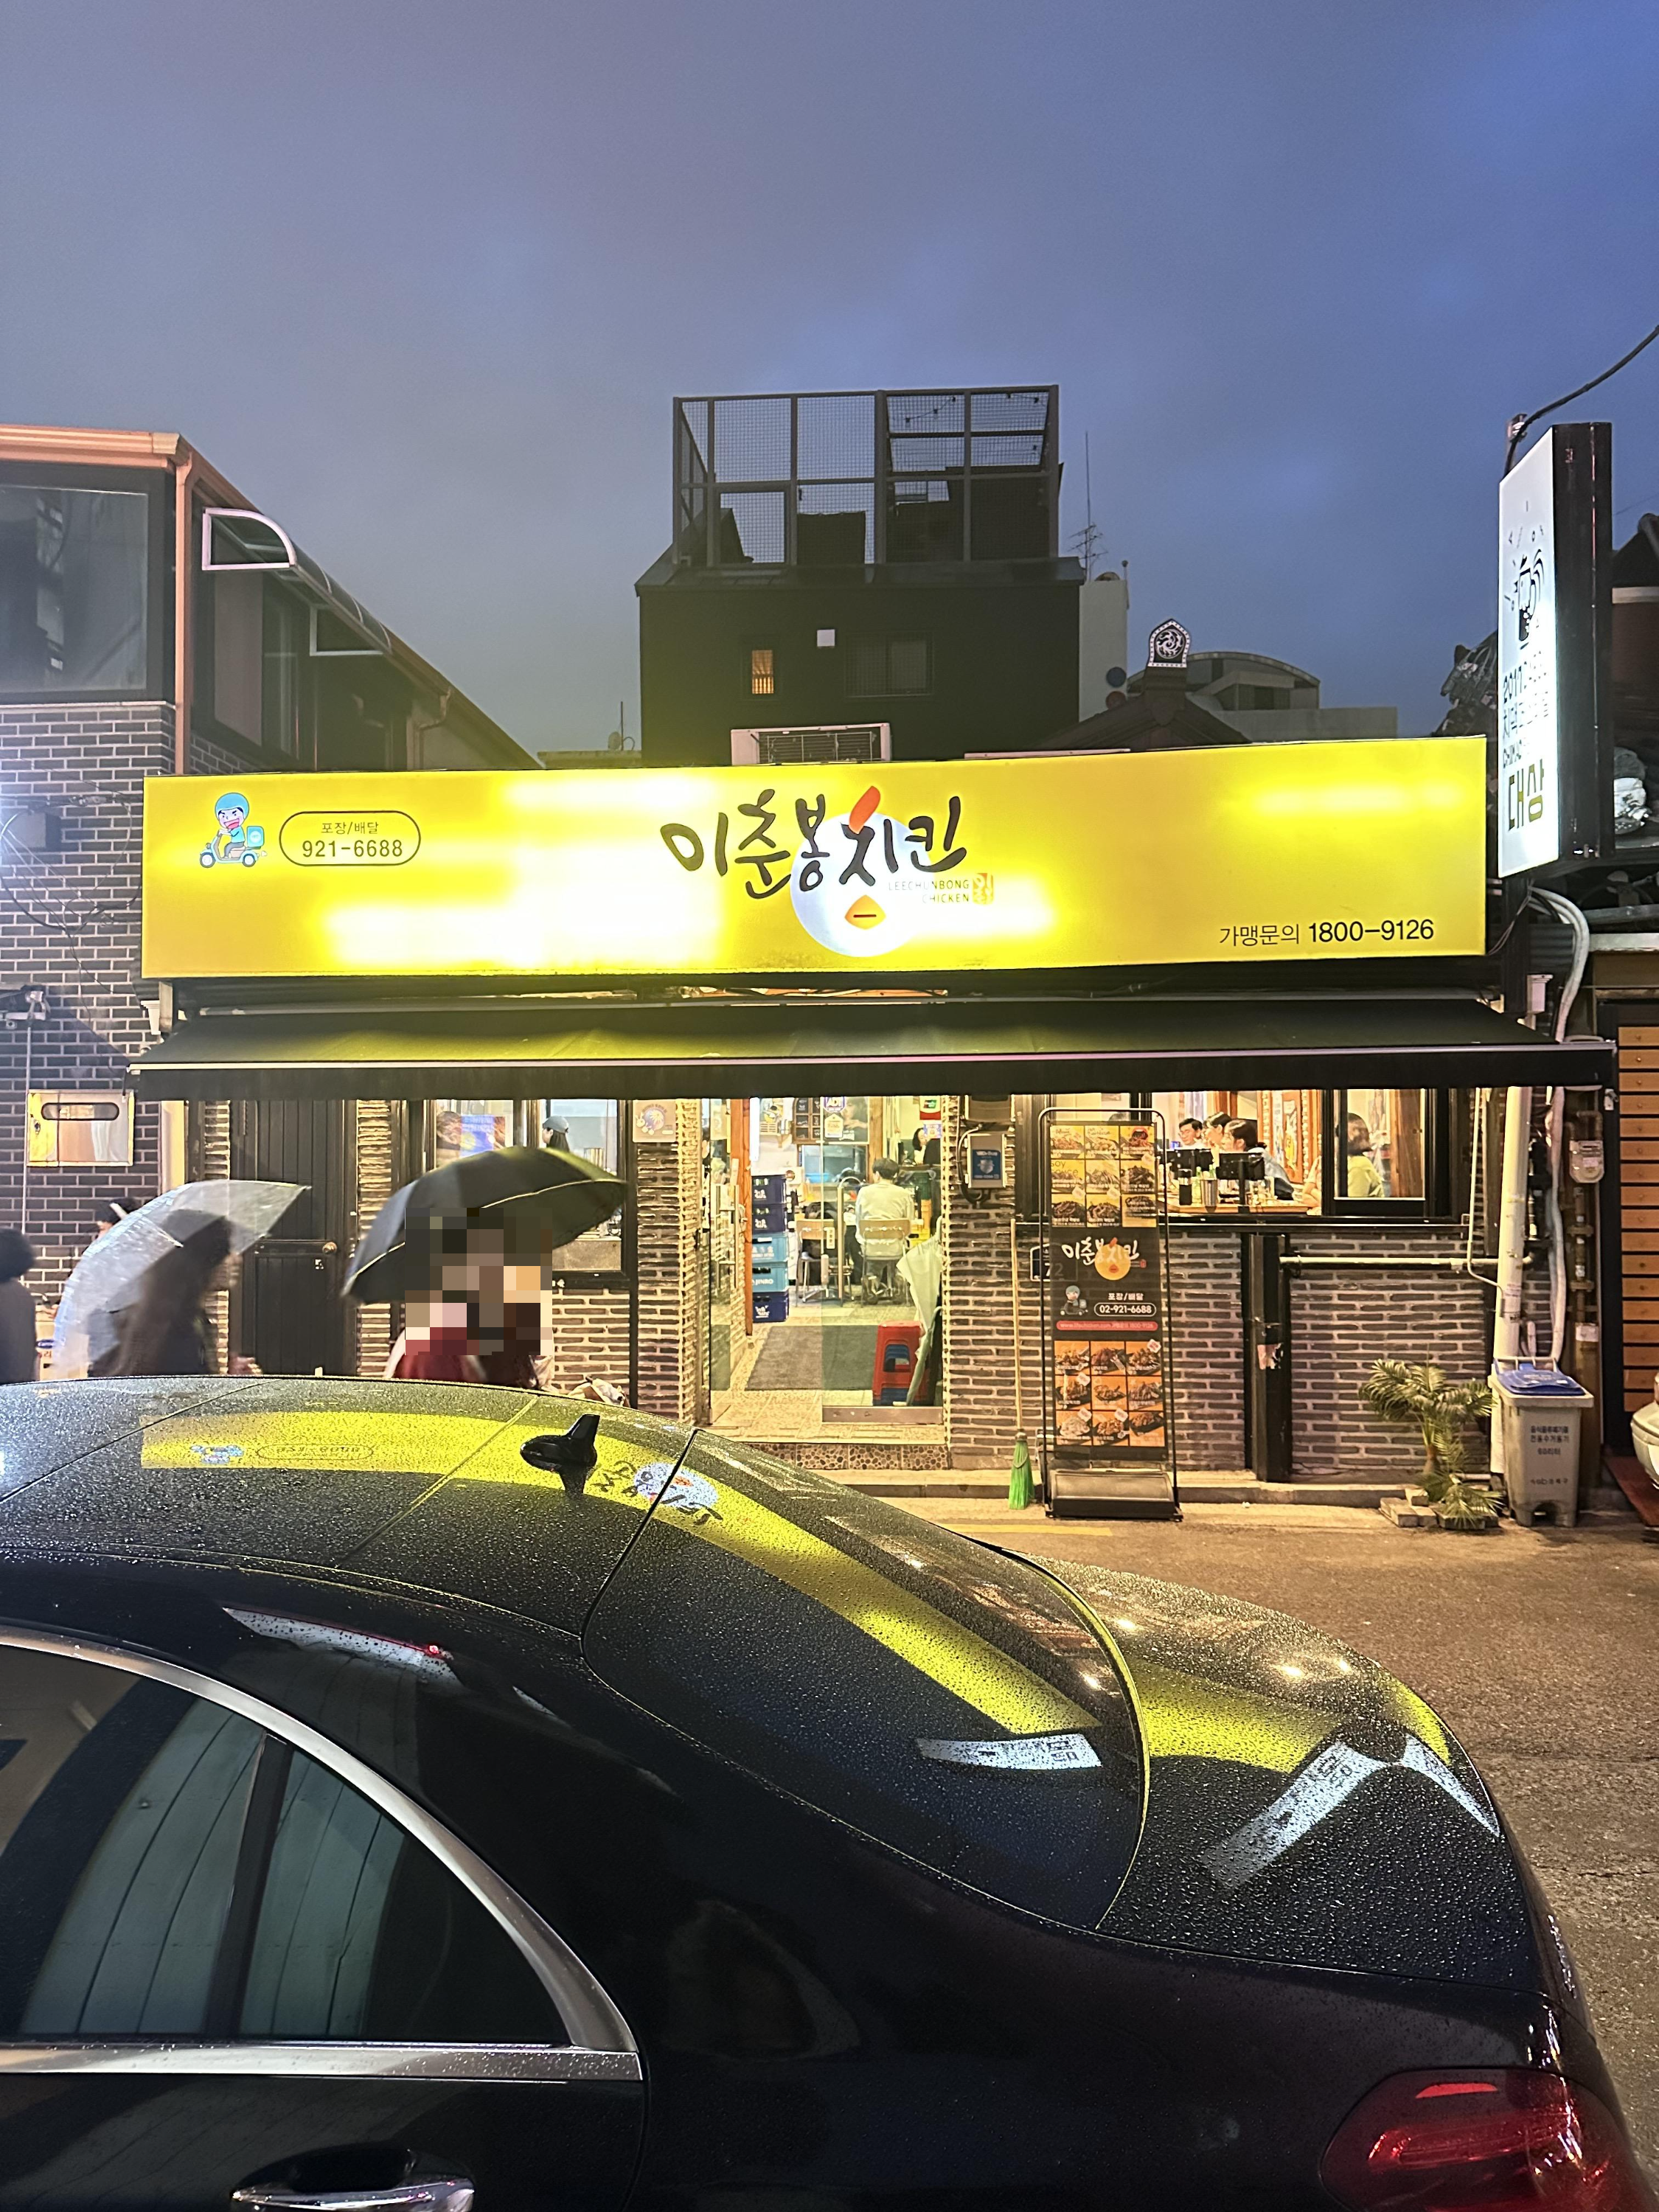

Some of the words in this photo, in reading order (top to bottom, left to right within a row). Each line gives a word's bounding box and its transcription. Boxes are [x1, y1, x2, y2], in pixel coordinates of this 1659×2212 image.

[1508, 758, 1545, 832] 대상
[319, 821, 380, 835] 포장/배달
[301, 839, 404, 858] 921-6688
[659, 785, 967, 900] 이춘봉치킨
[888, 879, 970, 891] LEECHUNBONG
[922, 893, 970, 903] CHICKEN
[1219, 923, 1300, 947] 가맹문의
[1308, 919, 1435, 943] 1800-9126
[1107, 1293, 1144, 1301] 포장/배달
[1099, 1304, 1152, 1314] 02-921-6688
